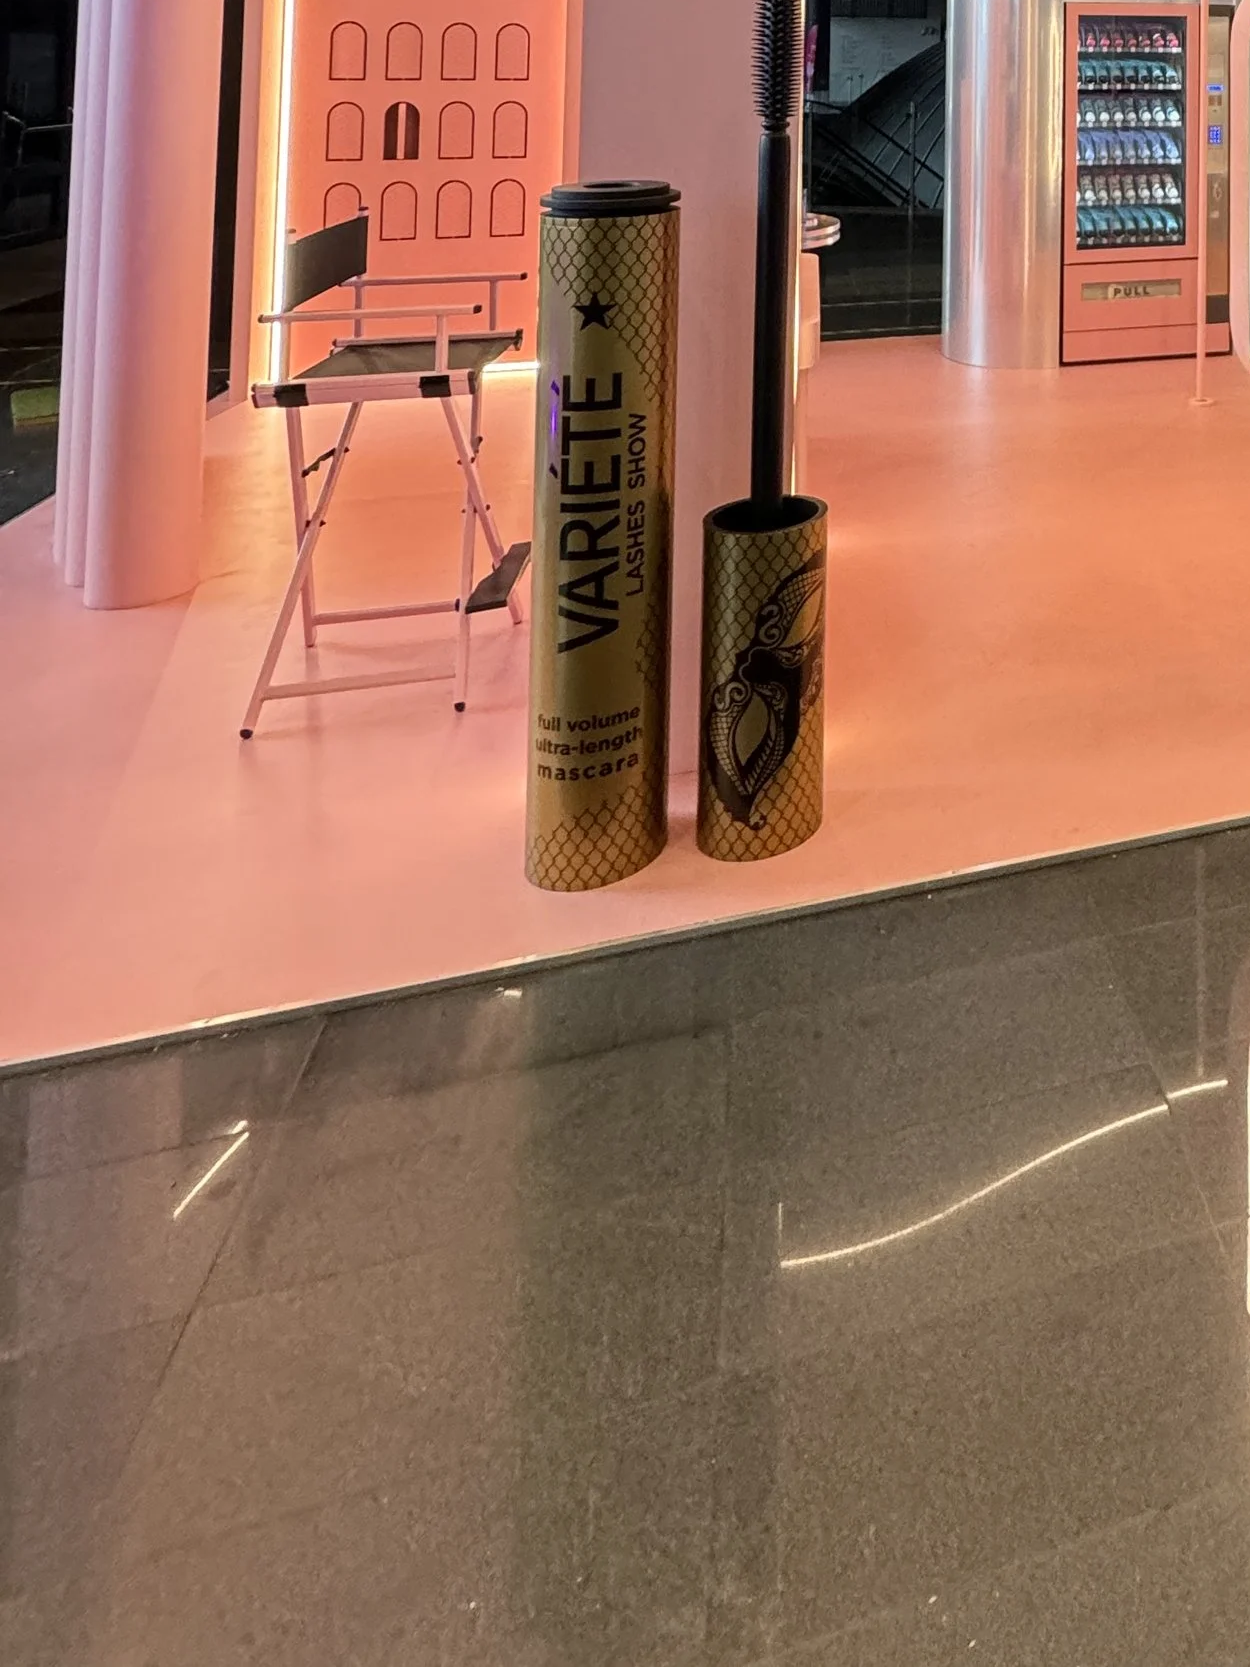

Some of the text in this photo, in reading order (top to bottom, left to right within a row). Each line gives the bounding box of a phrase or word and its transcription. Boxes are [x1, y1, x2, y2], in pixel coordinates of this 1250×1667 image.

[1113, 285, 1151, 297] PULL
[626, 413, 647, 597] LASHES SHOW
[538, 706, 640, 732] full volume
[535, 726, 643, 755] ultra-length
[537, 752, 639, 781] mascara
